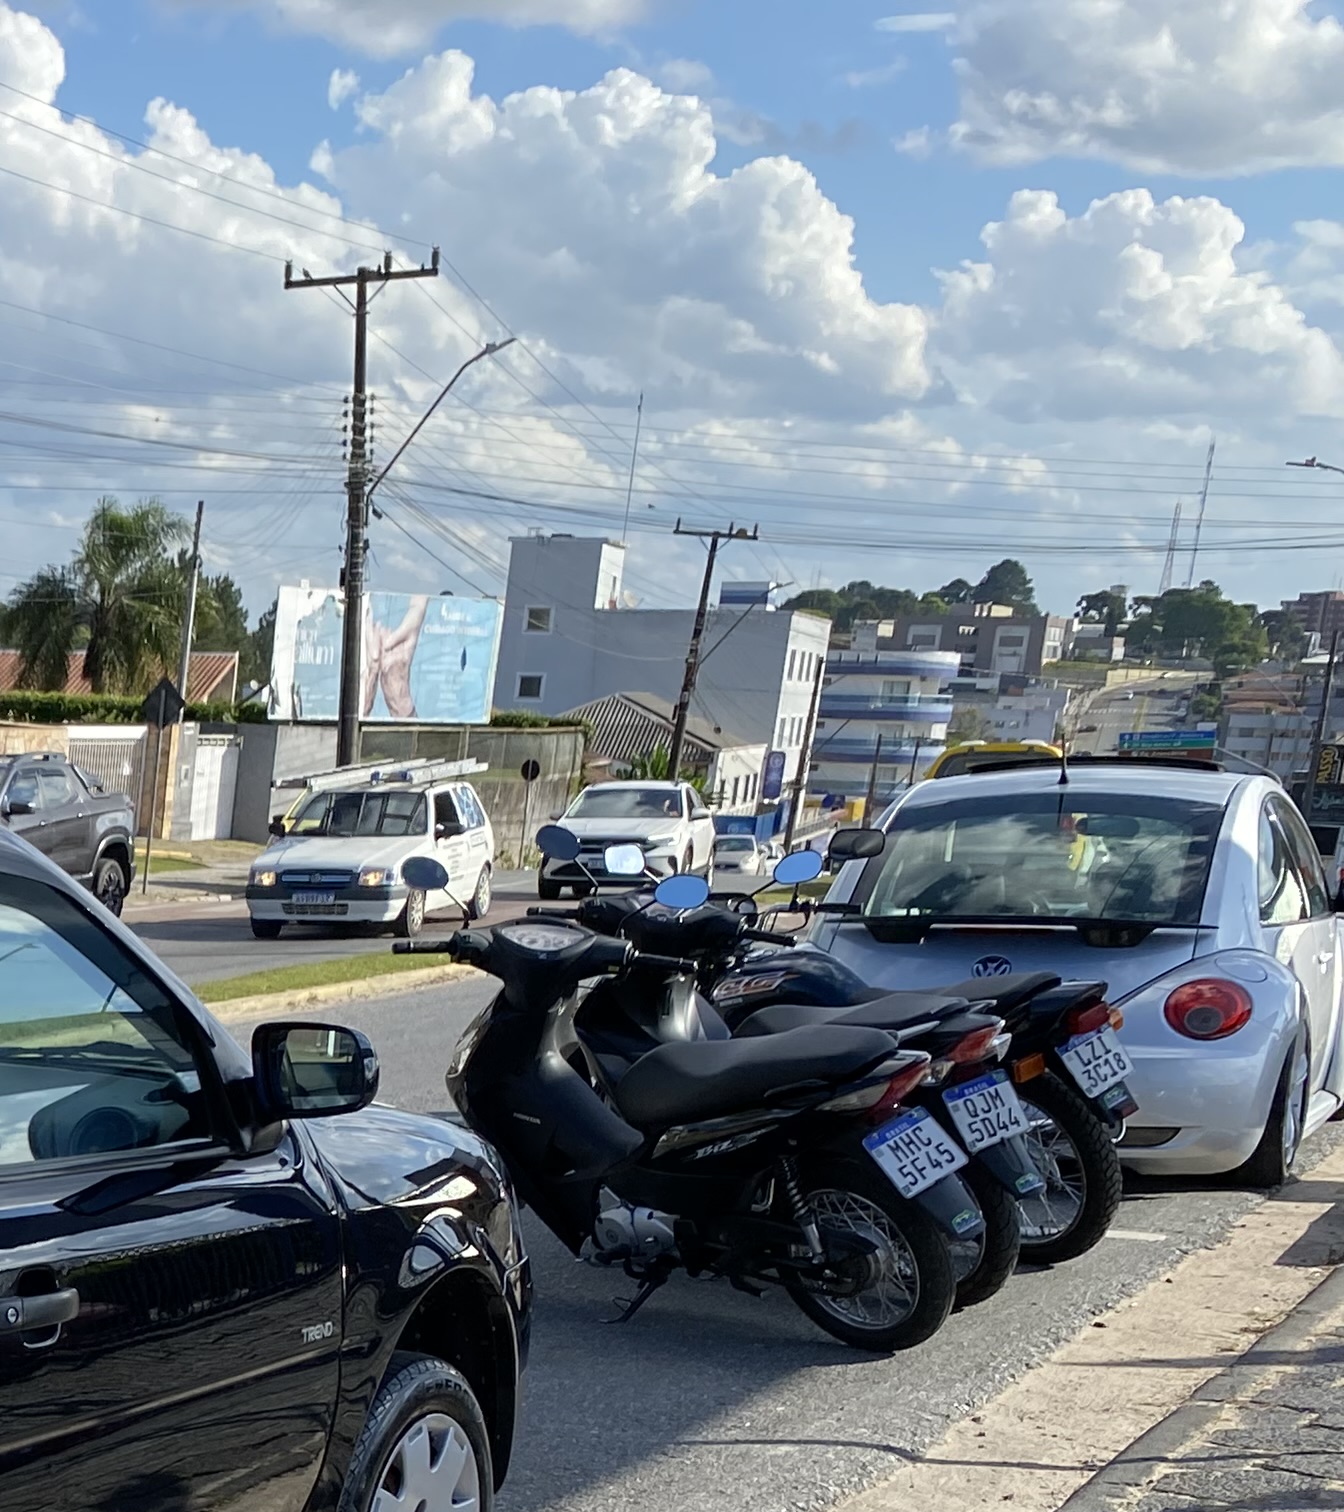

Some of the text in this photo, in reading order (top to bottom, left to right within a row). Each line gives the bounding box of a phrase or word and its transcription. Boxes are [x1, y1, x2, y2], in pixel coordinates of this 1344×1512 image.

[1074, 1035, 1112, 1067] LZI
[1081, 1051, 1127, 1088] 3C18
[963, 1087, 1006, 1118] QJM
[968, 1107, 1021, 1143] 5D44
[886, 1126, 932, 1163] MHC
[897, 1142, 956, 1187] 5F45
[301, 1321, 334, 1343] TREND
